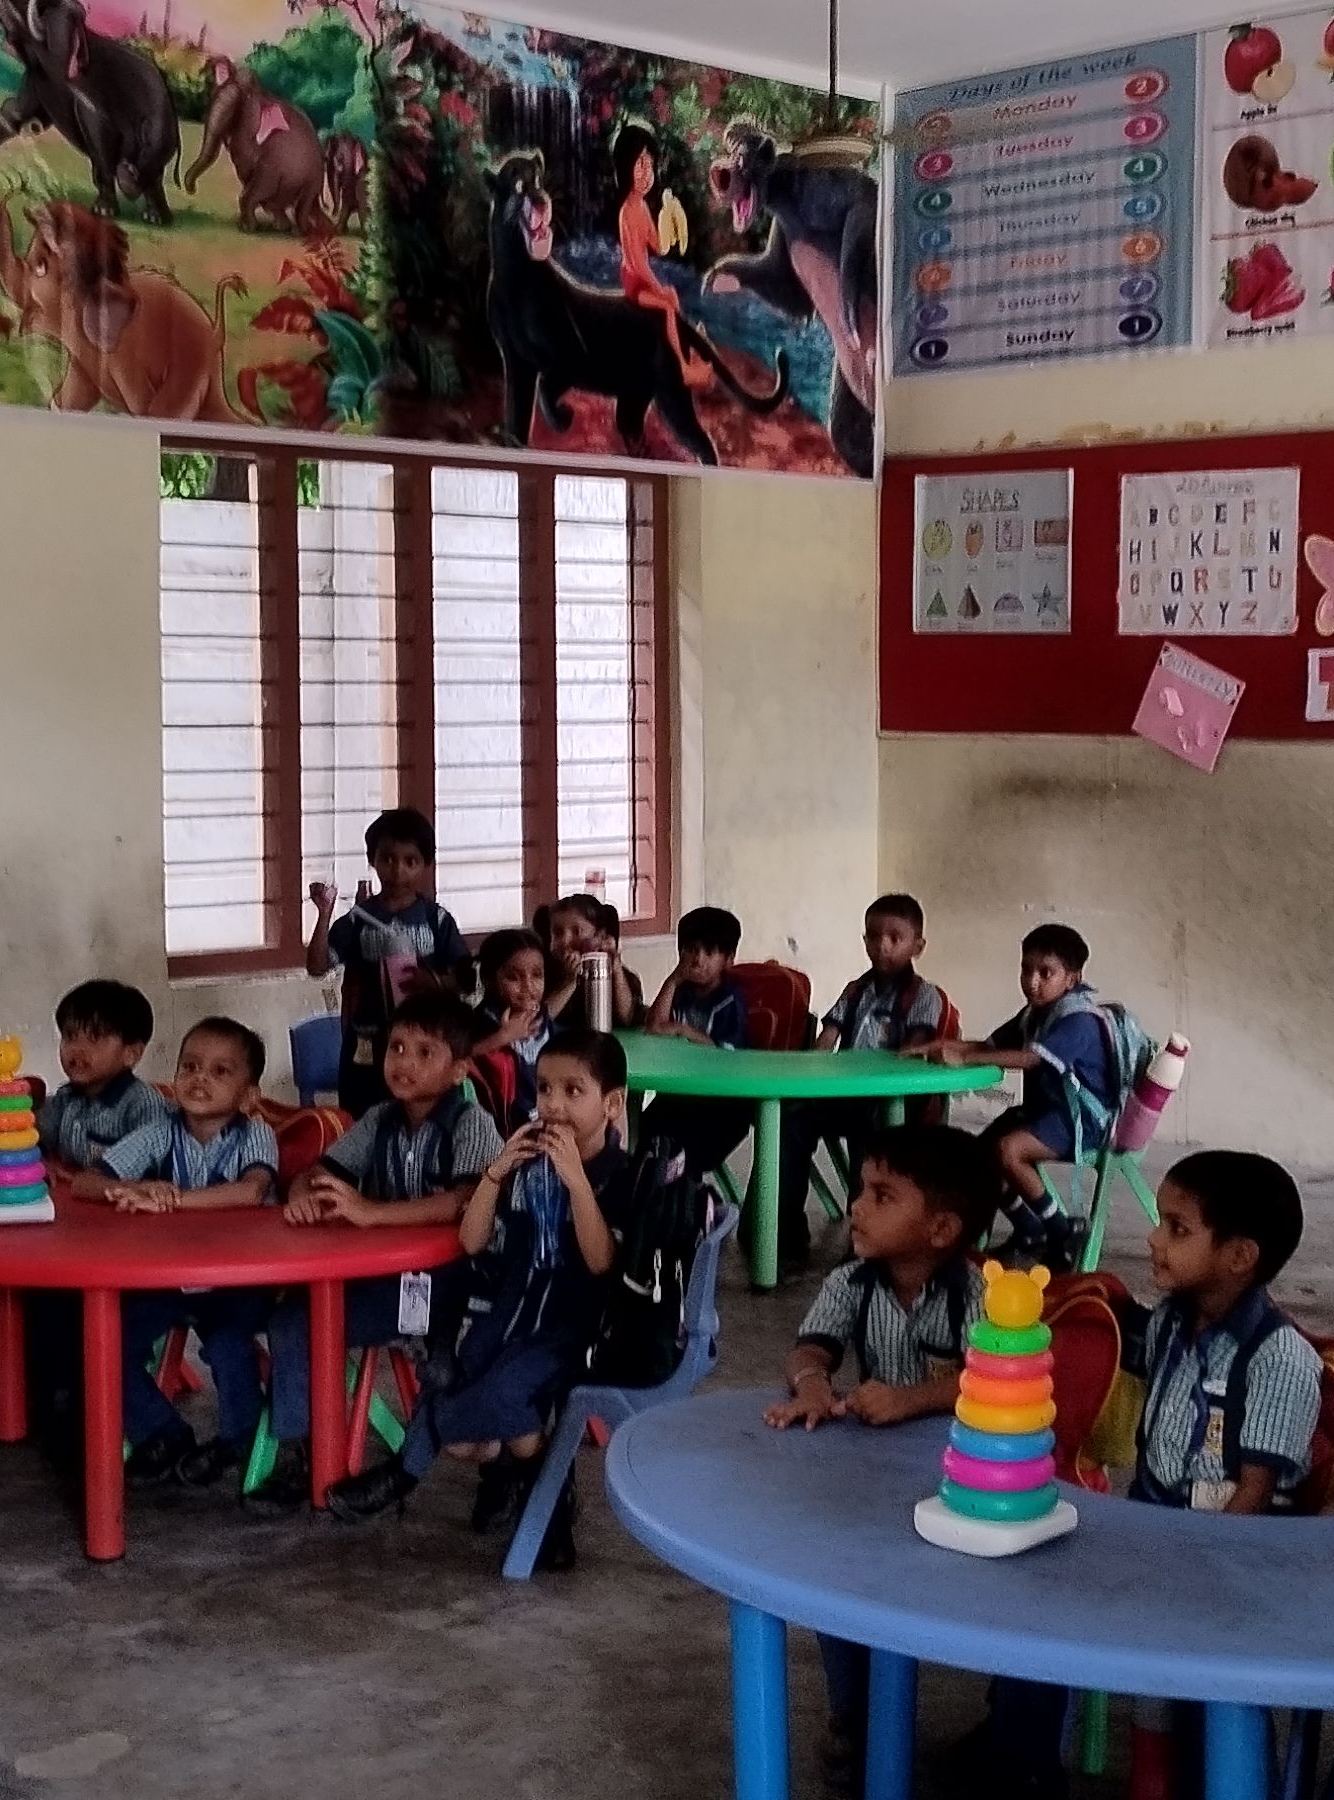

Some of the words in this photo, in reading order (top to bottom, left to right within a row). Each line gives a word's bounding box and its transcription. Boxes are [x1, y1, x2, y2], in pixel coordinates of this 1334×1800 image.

[993, 94, 1078, 119] Monday
[997, 135, 1075, 158] Tuesday
[983, 171, 1097, 198] Wednesday
[998, 290, 1081, 312] Saturday
[1005, 329, 1076, 347] Sunday
[960, 488, 1020, 513] SHAPES
[1168, 504, 1179, 526] C
[1129, 540, 1141, 564] H
[1191, 530, 1203, 559] K
[1213, 530, 1230, 558] L
[1270, 529, 1280, 553] N
[1170, 568, 1184, 596] Q
[1194, 568, 1208, 594] R
[1242, 566, 1258, 593] T
[1270, 565, 1281, 590] U
[1162, 602, 1179, 626] W
[1190, 602, 1203, 628] X
[1219, 601, 1229, 627] Y
[1241, 602, 1258, 625] Z
